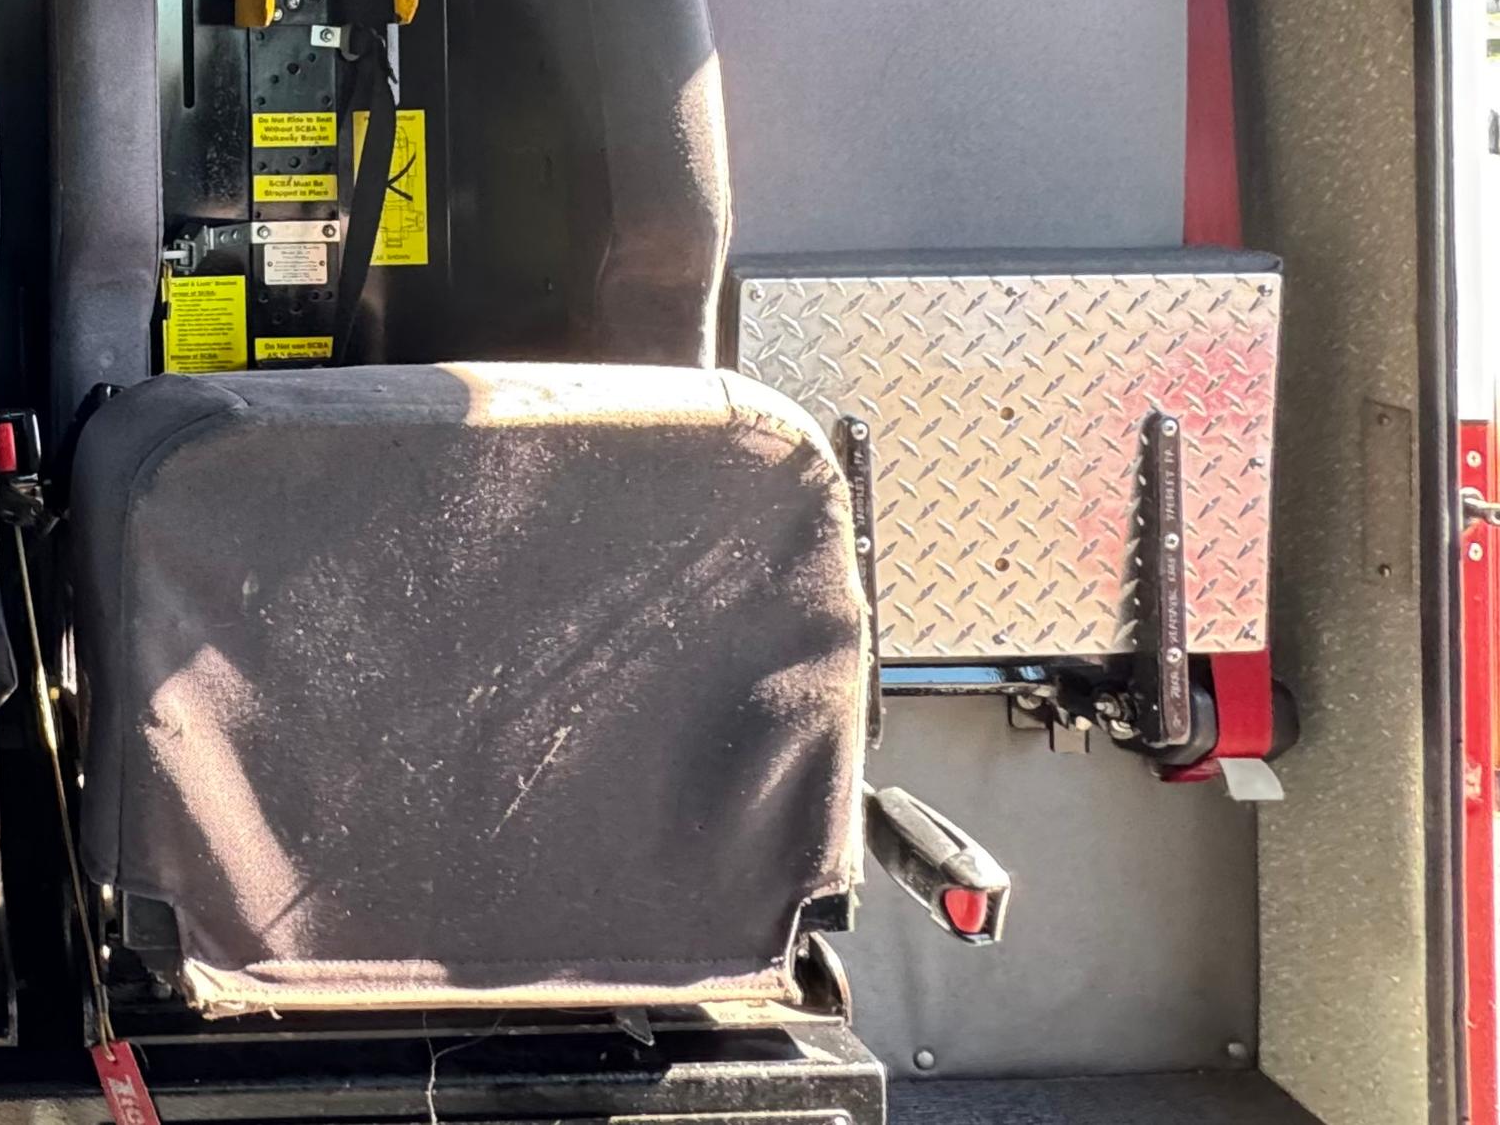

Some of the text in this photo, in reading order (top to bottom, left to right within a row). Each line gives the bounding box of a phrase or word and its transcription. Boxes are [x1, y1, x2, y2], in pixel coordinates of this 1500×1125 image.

[260, 135, 298, 143] Walkaway
[269, 179, 291, 187] SCBA
[264, 189, 298, 198] Strapped
